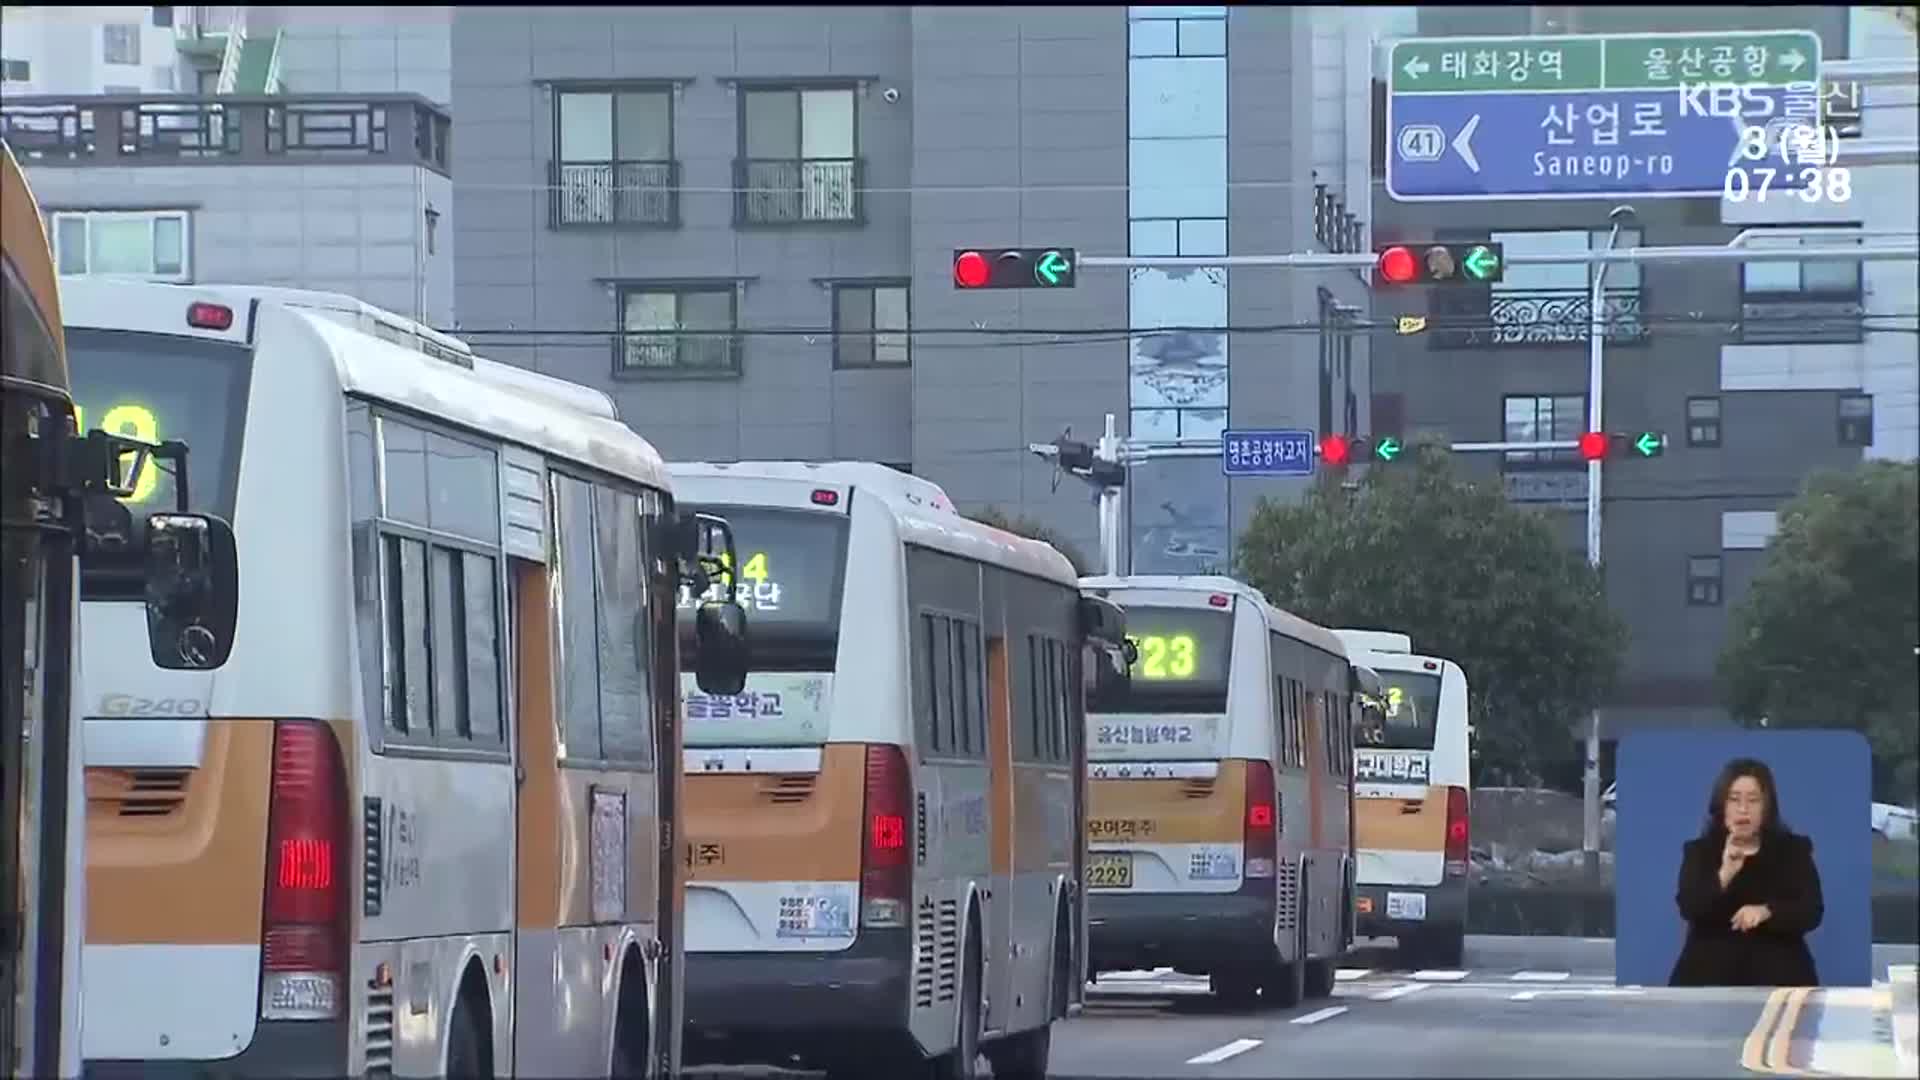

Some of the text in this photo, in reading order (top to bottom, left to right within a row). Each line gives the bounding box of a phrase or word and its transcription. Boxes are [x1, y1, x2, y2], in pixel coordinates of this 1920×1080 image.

[1441, 49, 1563, 82] 태화강역
[1643, 46, 1769, 81] 울산공항
[1540, 102, 1668, 146] 산업로
[1408, 132, 1435, 154] 41
[1533, 151, 1673, 179] Saneop-ro
